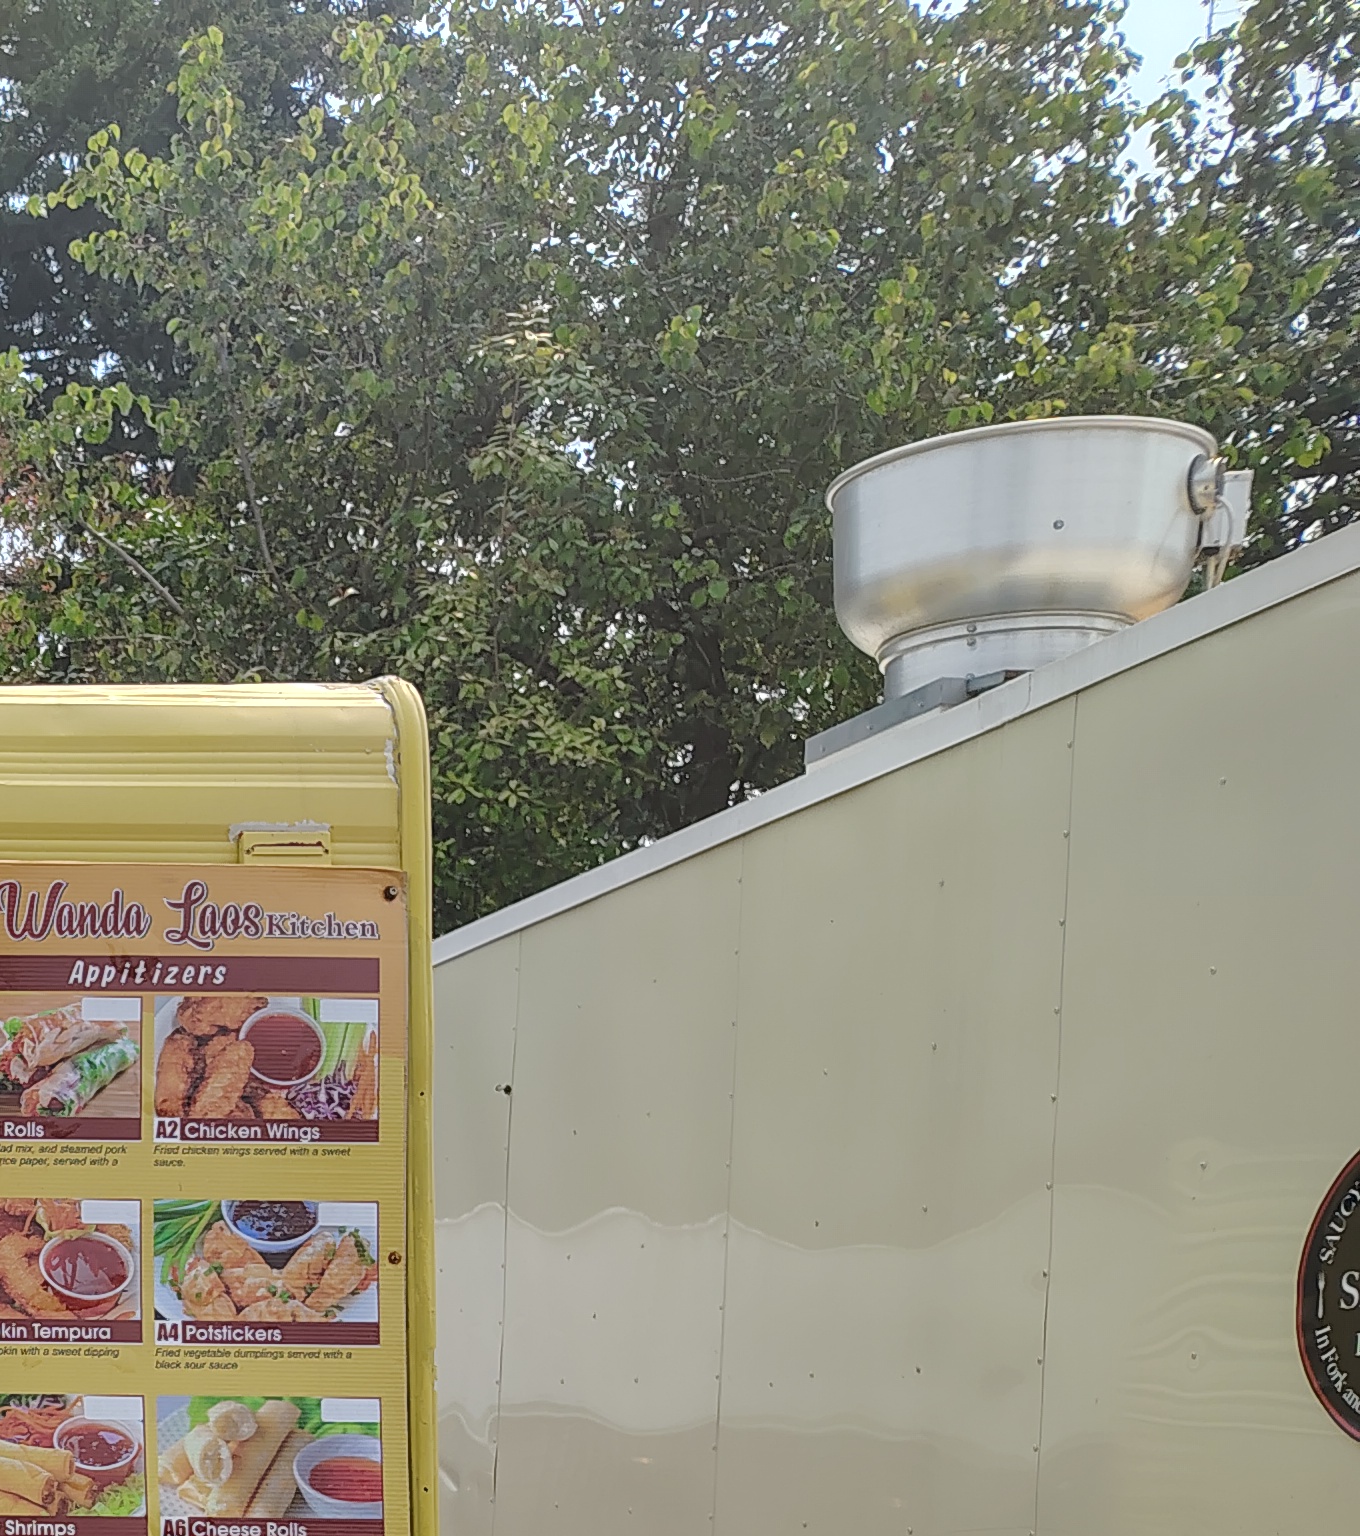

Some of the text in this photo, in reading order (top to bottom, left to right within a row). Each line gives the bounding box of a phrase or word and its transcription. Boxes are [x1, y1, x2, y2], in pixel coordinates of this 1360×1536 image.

[163, 879, 263, 950] Laos
[264, 914, 380, 940] Kitchen
[68, 960, 227, 987] Appitizers
[4, 1123, 44, 1137] Rolls
[156, 1121, 320, 1141] A2 Chicken Wings
[153, 1146, 179, 1155] Fried
[182, 1147, 219, 1155] chicken
[222, 1148, 250, 1157] wings
[254, 1148, 287, 1156] served
[290, 1148, 309, 1156] with
[32, 1324, 111, 1341] Tempura
[158, 1323, 281, 1341] A4 Potstickers
[1315, 1325, 1331, 1349] In
[20, 1347, 40, 1355] with
[52, 1348, 81, 1356] sweet
[84, 1347, 119, 1358] dipping
[155, 1348, 180, 1356] Fried
[184, 1348, 231, 1358] vegetable
[234, 1349, 284, 1359] dumplings
[288, 1350, 320, 1358] served
[323, 1350, 344, 1358] with
[1320, 1347, 1348, 1392] Fork
[164, 1519, 186, 1536] A6
[192, 1521, 261, 1536] Cheese
